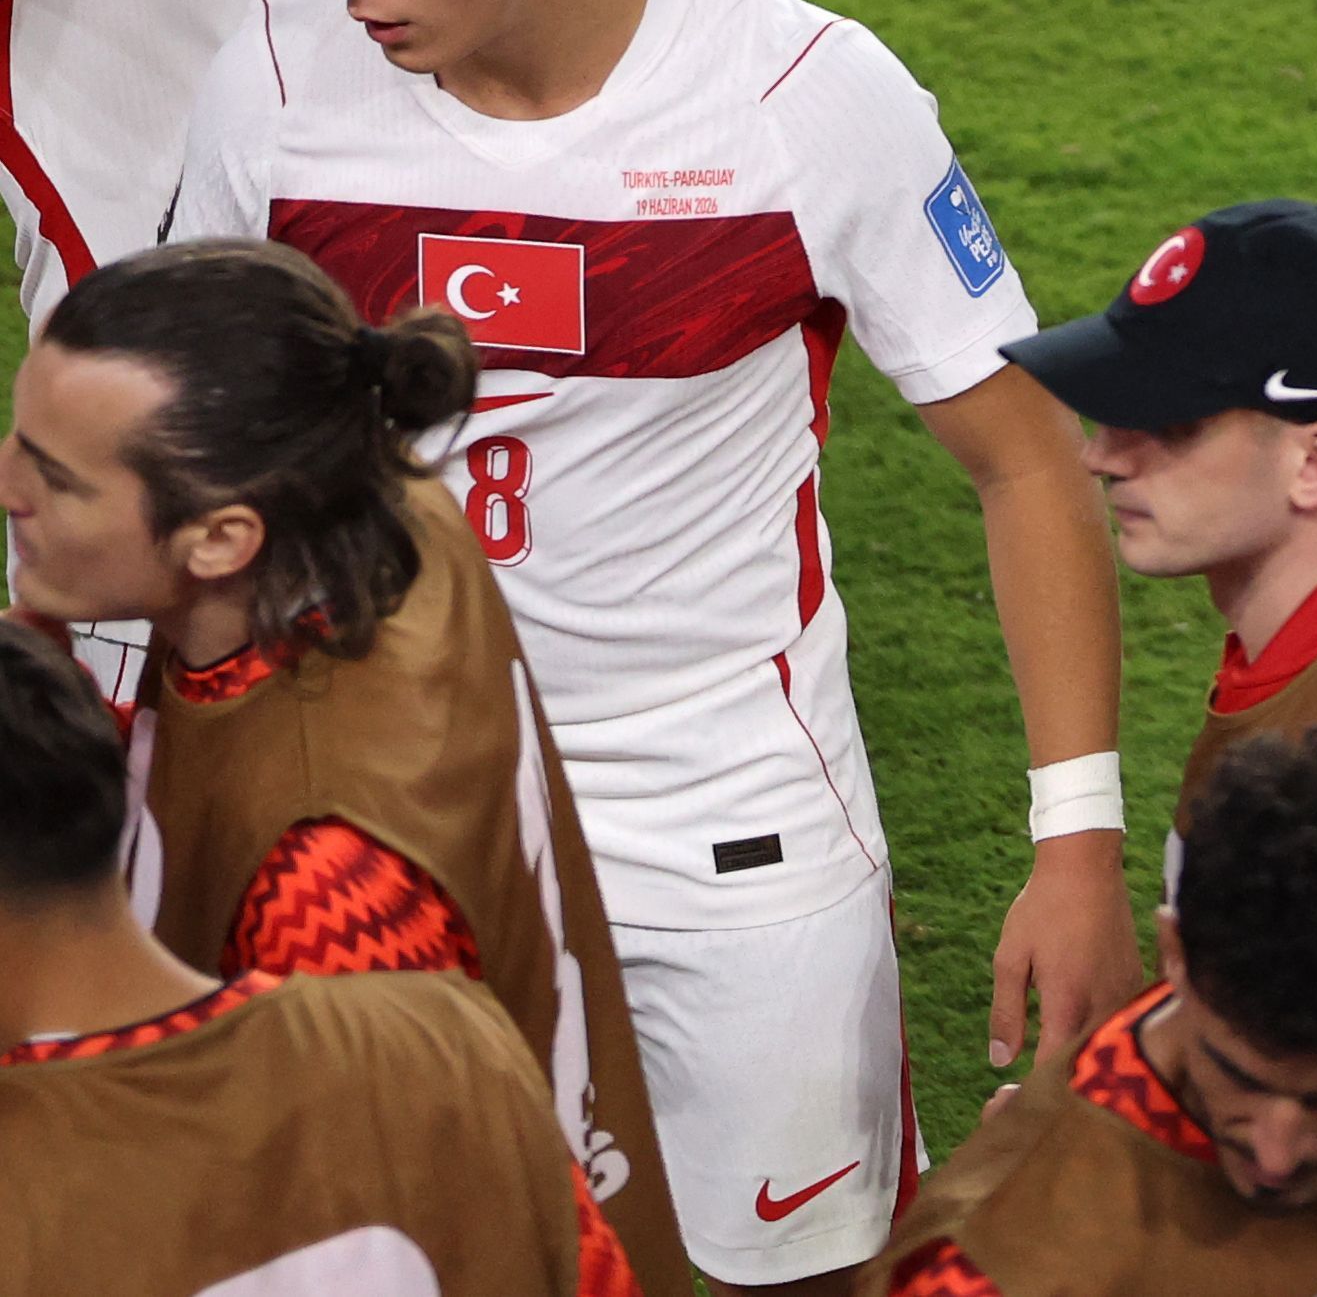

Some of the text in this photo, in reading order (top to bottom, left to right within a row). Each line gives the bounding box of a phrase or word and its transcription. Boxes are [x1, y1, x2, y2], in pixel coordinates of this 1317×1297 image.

[636, 199, 648, 216] 19
[649, 194, 692, 215] HAZİRAN
[465, 436, 532, 567] 8
